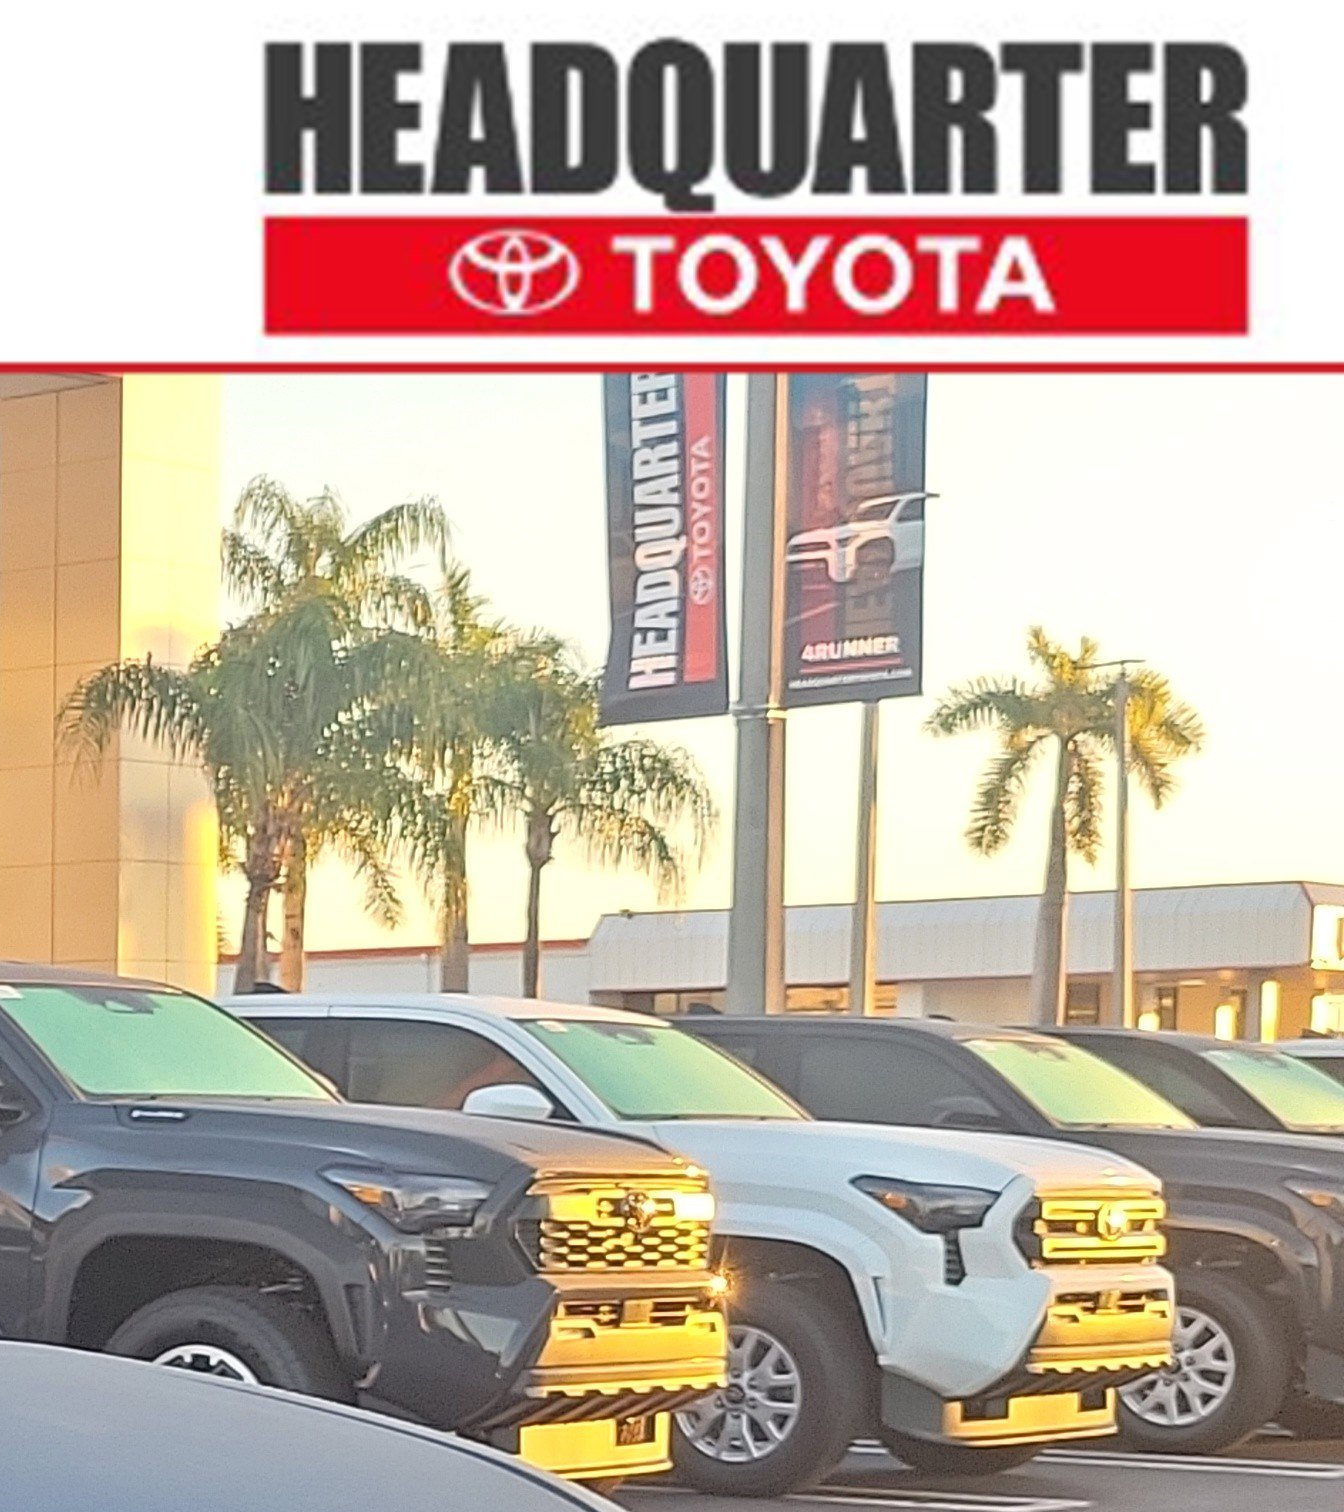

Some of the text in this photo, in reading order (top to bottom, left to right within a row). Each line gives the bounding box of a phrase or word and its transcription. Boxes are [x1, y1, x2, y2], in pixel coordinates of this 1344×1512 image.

[629, 373, 685, 690] HEADQUARTER
[690, 436, 713, 562] TOYOTA
[801, 636, 899, 662] 4RUNNER
